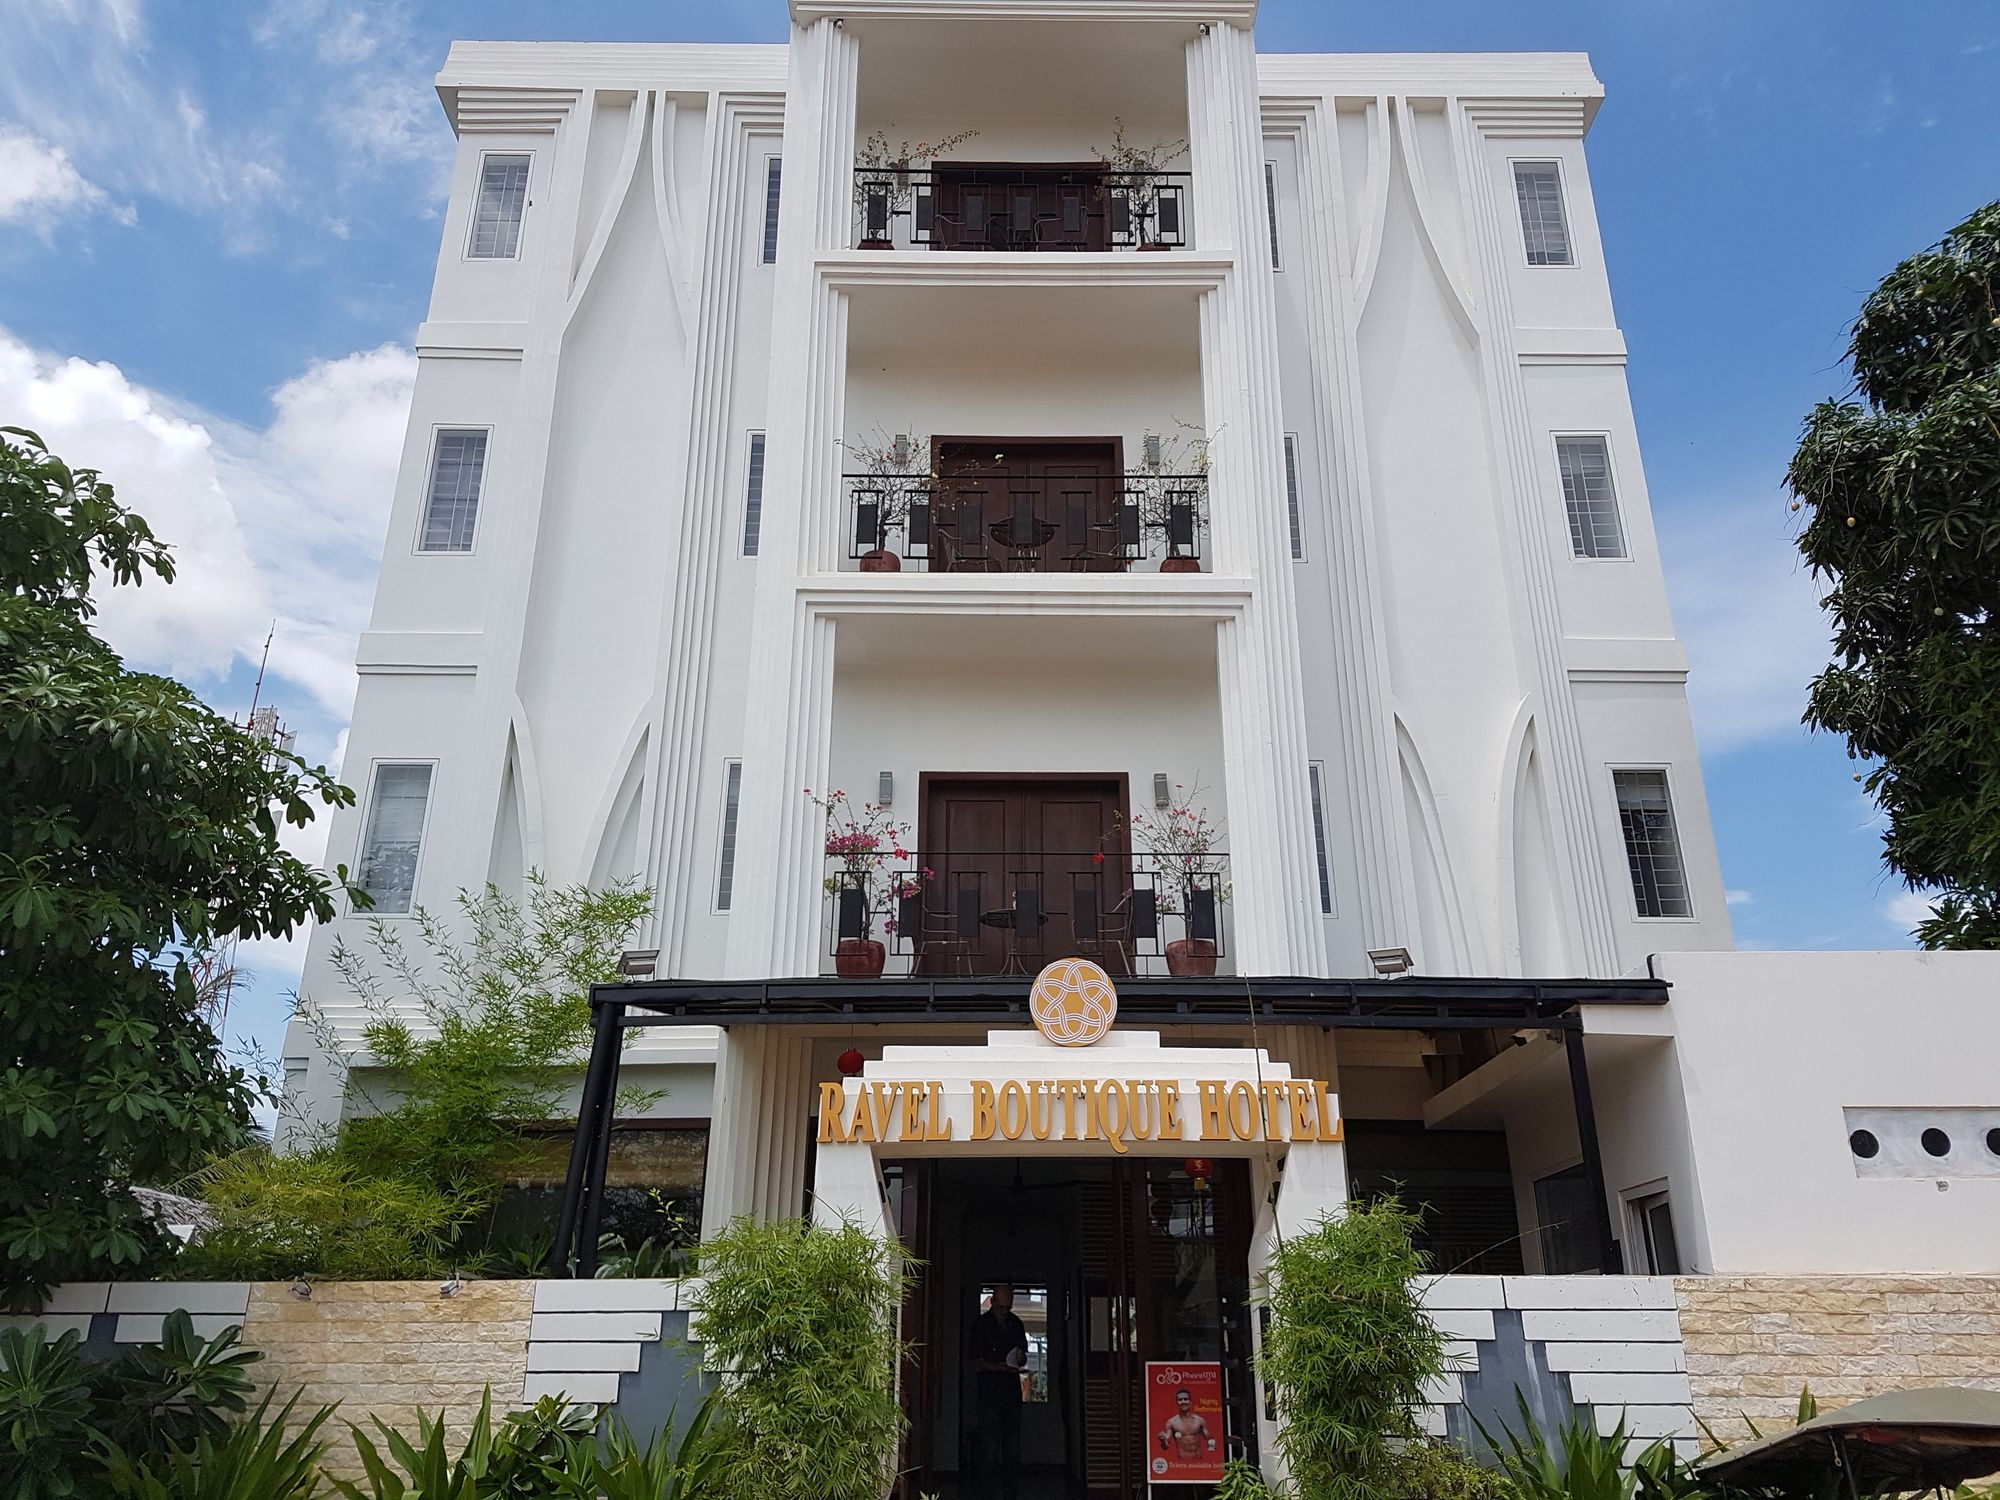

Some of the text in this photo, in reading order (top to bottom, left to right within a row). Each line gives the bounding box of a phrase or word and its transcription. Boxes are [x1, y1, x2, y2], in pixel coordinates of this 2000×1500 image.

[816, 1079, 1344, 1154] RAVEL BOUTIQUE HOTEL
